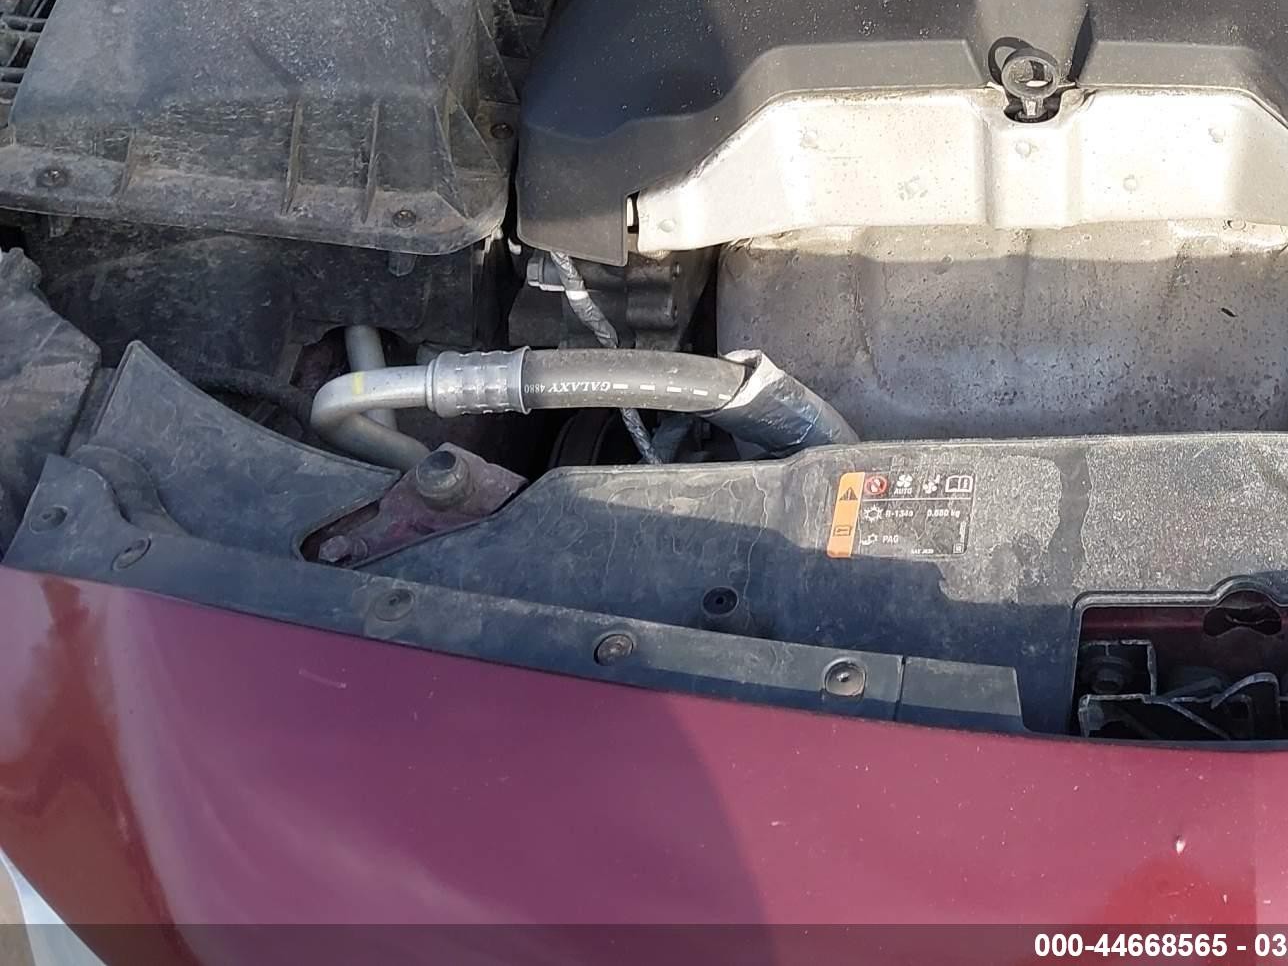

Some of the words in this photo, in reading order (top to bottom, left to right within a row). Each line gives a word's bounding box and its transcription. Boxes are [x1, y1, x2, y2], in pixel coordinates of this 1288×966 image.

[547, 380, 611, 393] GALAXY
[893, 487, 913, 495] AUTO
[882, 534, 899, 544] PAG
